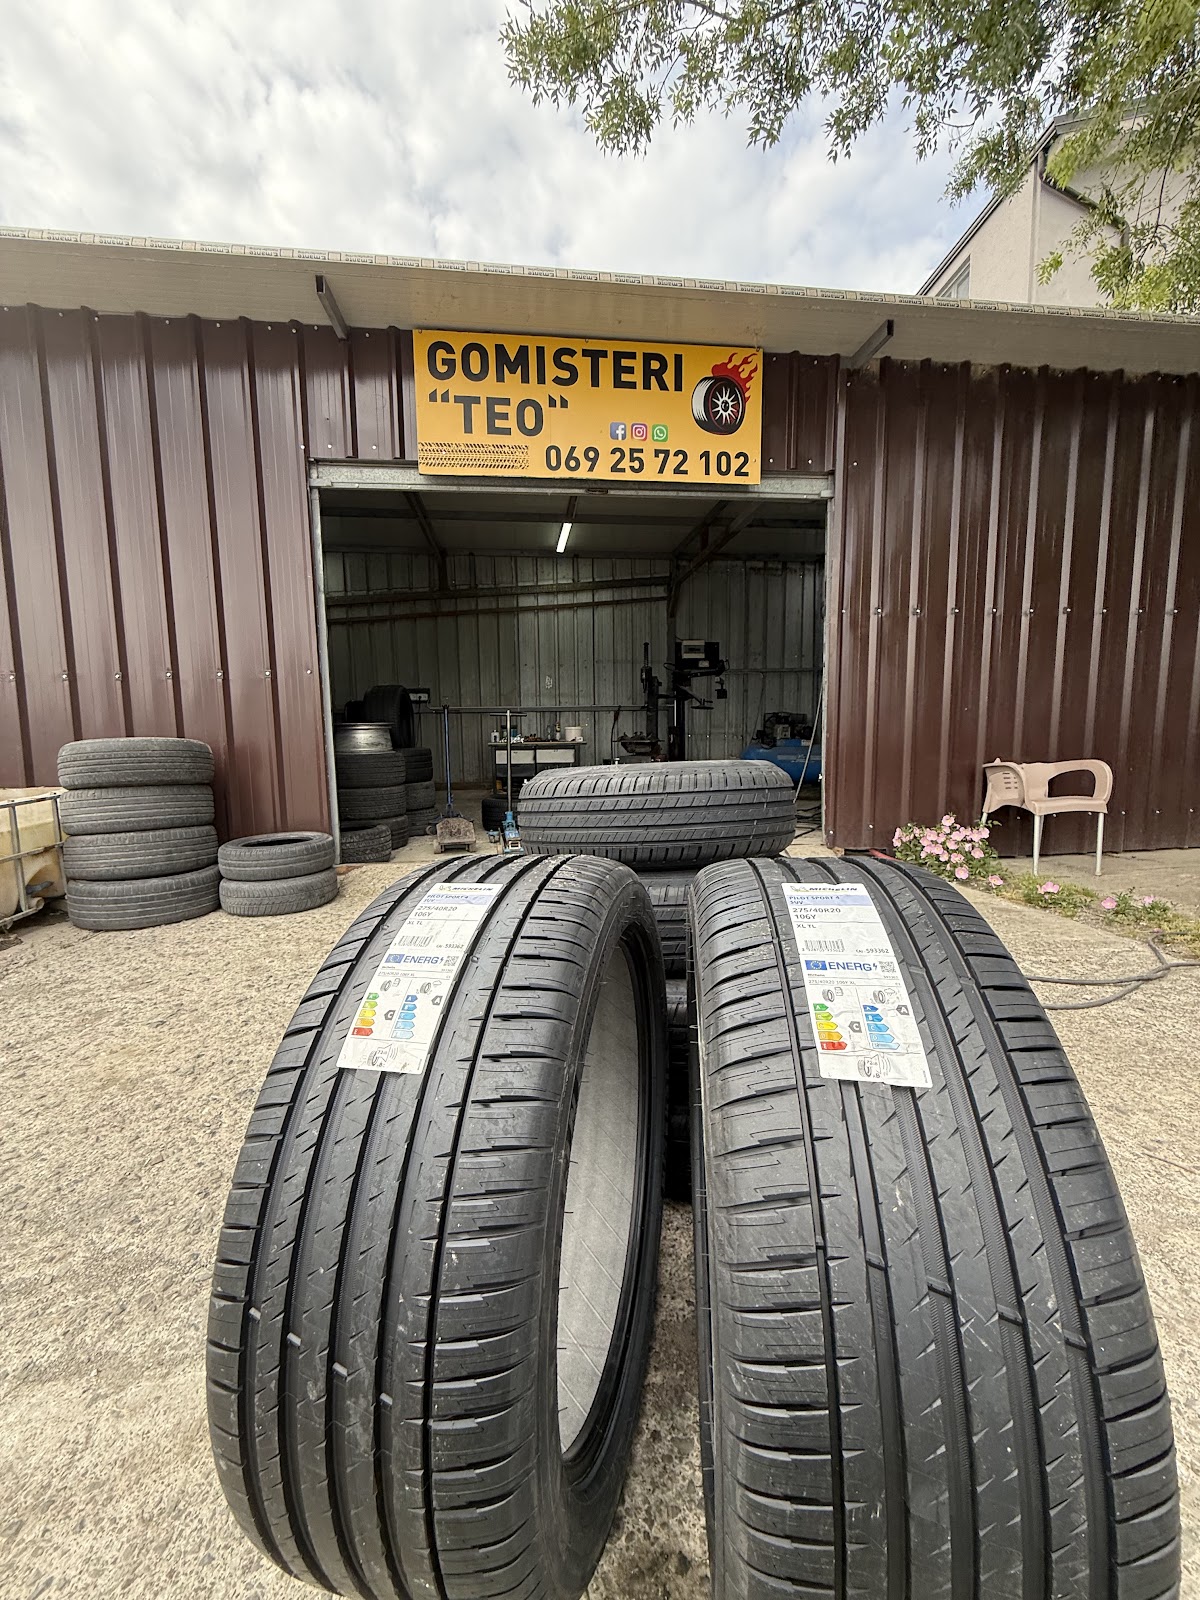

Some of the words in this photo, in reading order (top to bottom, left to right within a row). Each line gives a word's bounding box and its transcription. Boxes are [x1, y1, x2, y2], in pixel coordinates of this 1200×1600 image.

[426, 340, 683, 392] GOMISTERI
[545, 445, 599, 472] 069
[610, 447, 644, 473] 25
[654, 449, 688, 474] 72
[699, 450, 749, 476] 102
[403, 955, 438, 964] ENERG
[828, 962, 872, 971] ENERG
